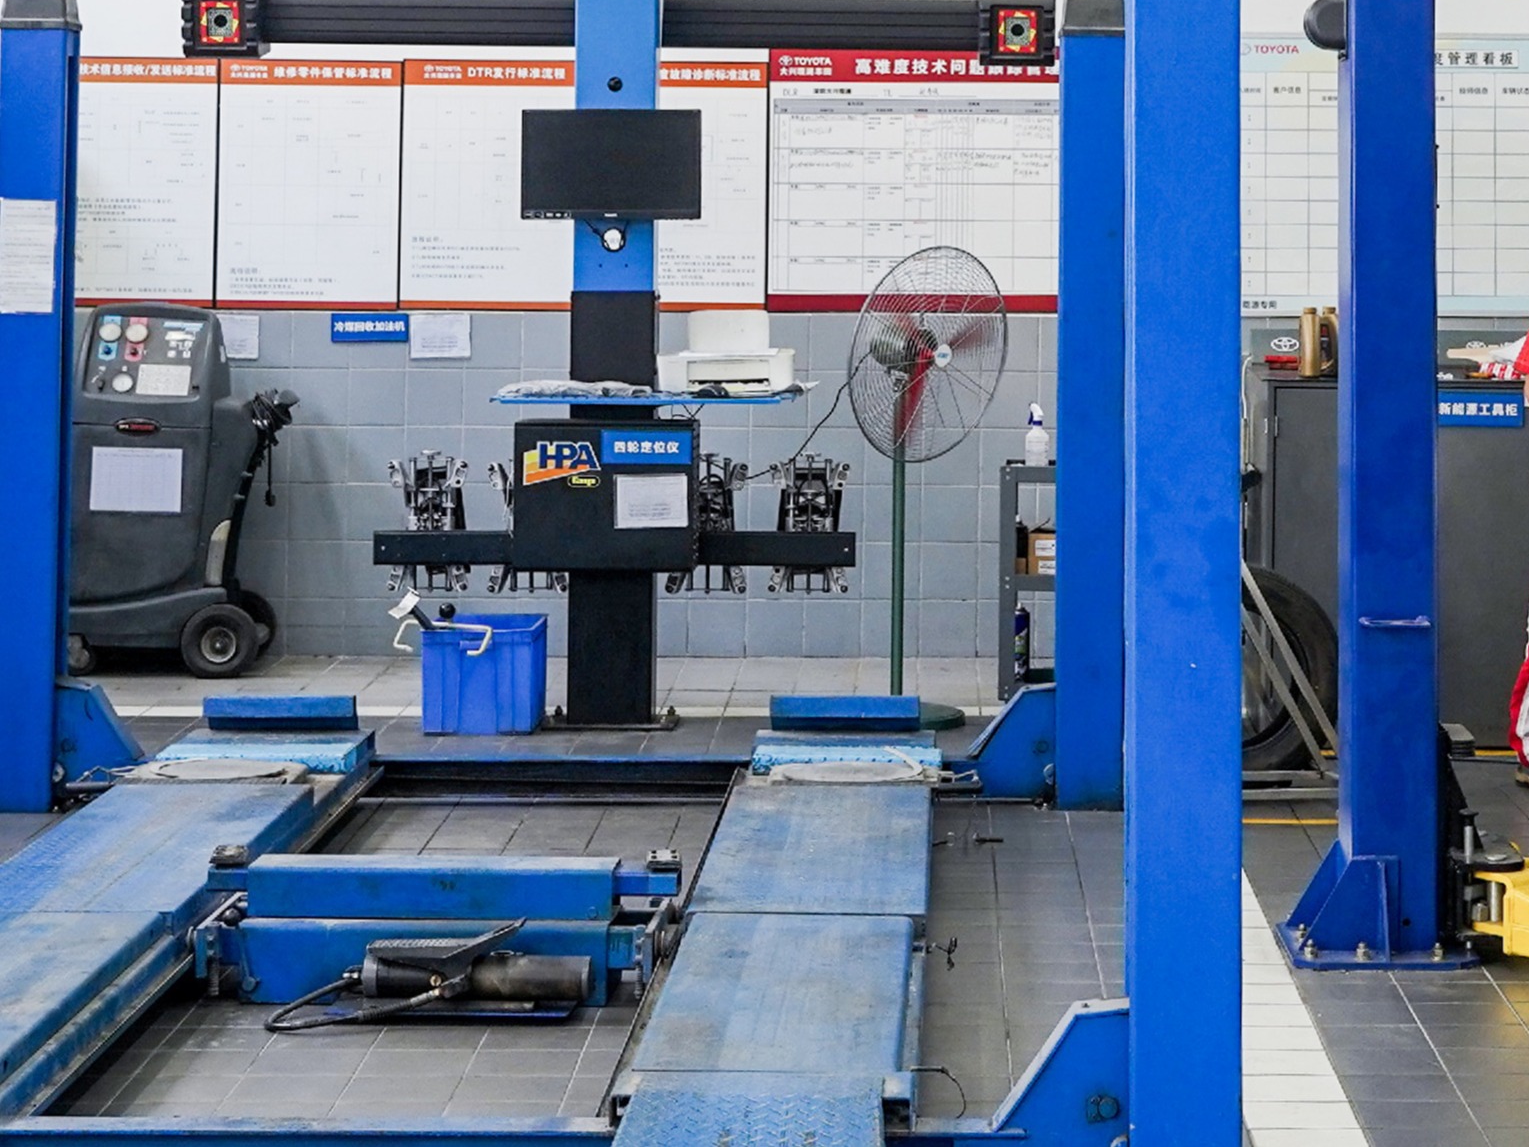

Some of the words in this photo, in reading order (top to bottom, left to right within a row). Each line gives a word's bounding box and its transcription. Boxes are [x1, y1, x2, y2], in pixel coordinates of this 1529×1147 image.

[1253, 44, 1300, 54] TOYOTA
[794, 56, 833, 66] TOYOTA
[467, 67, 566, 80] DTR发行标准流程
[1438, 402, 1518, 416] 新能源工具柜
[613, 441, 679, 453] 四轮定位仪
[537, 441, 602, 471] HPA
